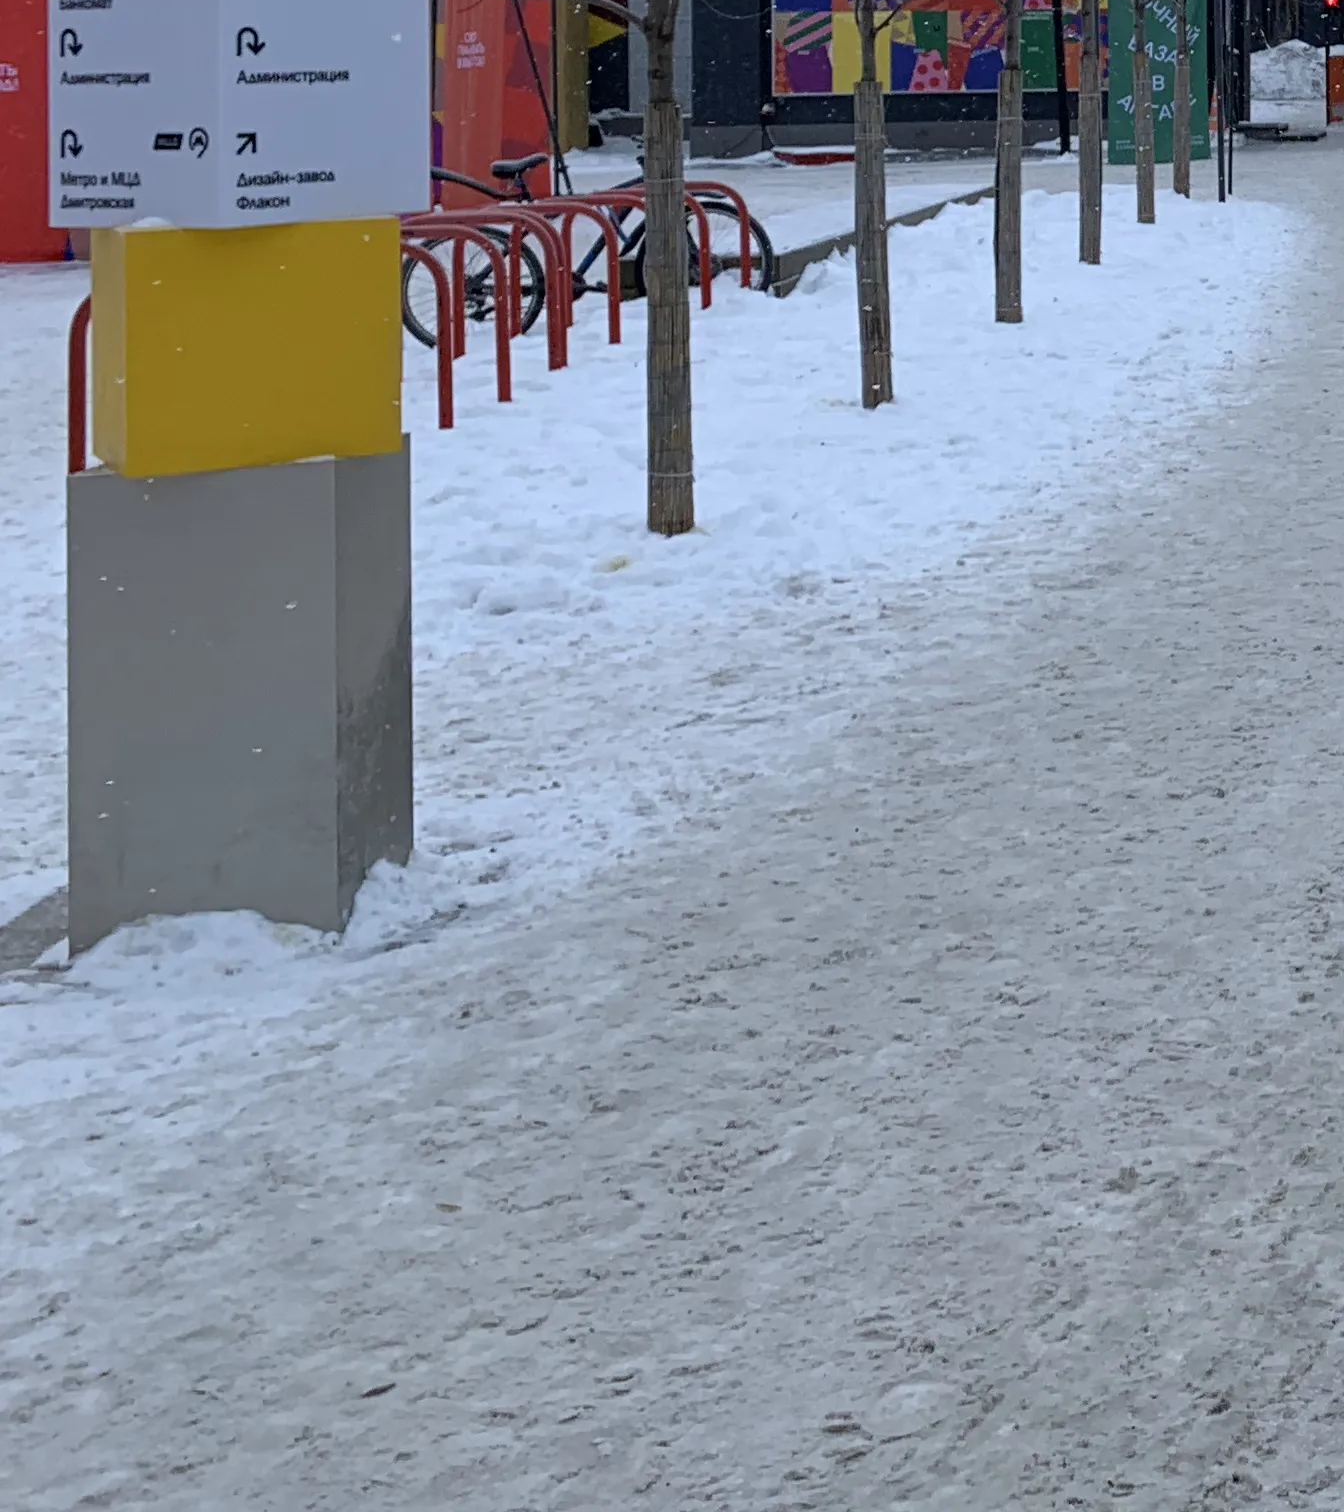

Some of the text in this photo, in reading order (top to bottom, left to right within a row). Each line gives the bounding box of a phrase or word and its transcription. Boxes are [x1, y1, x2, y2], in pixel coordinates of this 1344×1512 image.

[60, 71, 150, 86] Администрация
[236, 69, 350, 86] Администрация
[1152, 75, 1165, 91] В
[60, 171, 141, 189] Метро и МЦД
[236, 170, 335, 189] Дизайн-завод
[236, 195, 291, 210] Флакон
